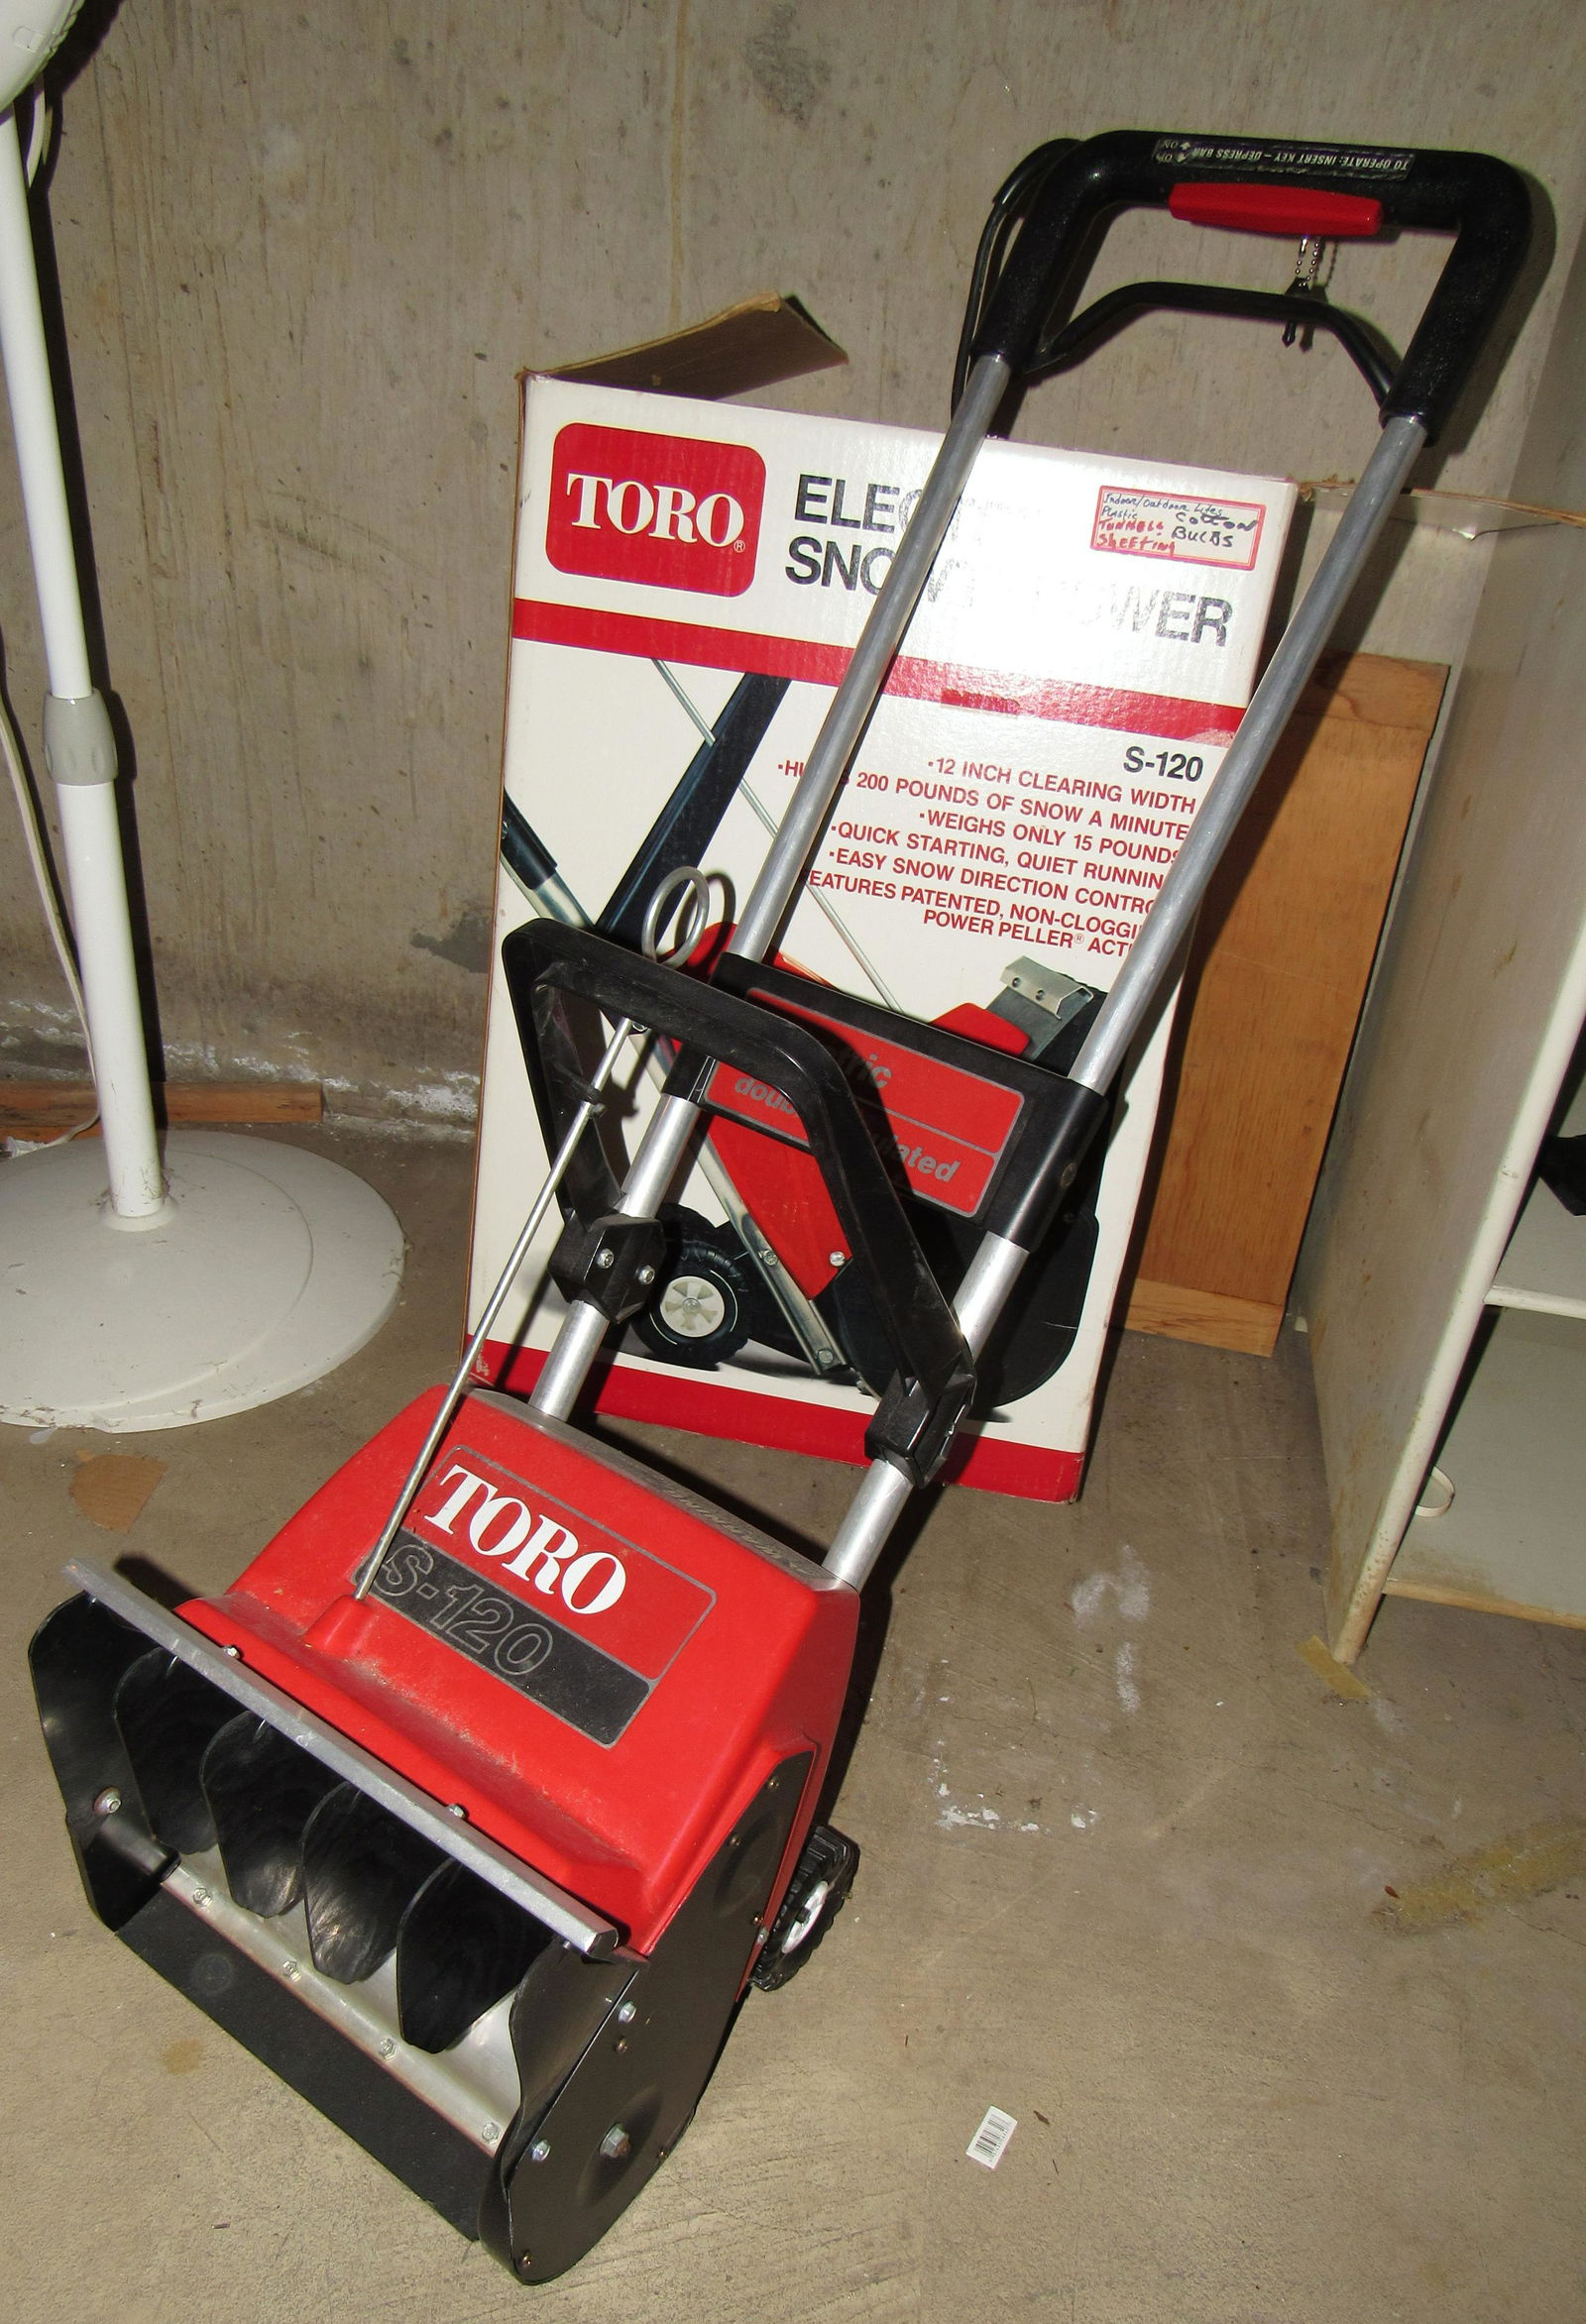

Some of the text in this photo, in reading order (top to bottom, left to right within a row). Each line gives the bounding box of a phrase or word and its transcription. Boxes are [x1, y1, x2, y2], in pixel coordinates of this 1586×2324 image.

[1216, 149, 1263, 162] DEPRESS
[1275, 153, 1295, 164] KEY
[1297, 154, 1338, 166] INSERT
[1394, 160, 1411, 171] TO
[962, 760, 1012, 784] INCH
[1018, 770, 1123, 803] CLEARING
[1130, 788, 1196, 815] WIDTH
[1123, 745, 1204, 782] S-120
[856, 771, 889, 792] 200
[895, 777, 979, 807] POUNDS
[986, 792, 1015, 812] OF
[1019, 798, 1083, 824] SNOW
[1088, 810, 1103, 828] A
[1109, 813, 1190, 841] MINUTE
[927, 809, 1006, 837] WEIGHS
[1012, 824, 1067, 846] ONLY
[1073, 833, 1093, 851] 15
[838, 821, 1165, 891] QUICK STARTING, QUIET RUNNIN
[836, 847, 1156, 915] EASY SNOW DIRECTION CONTRO
[809, 870, 1143, 941] EATURES PATENTED, NON-CLOGGI
[923, 909, 993, 936] POWER
[424, 1463, 627, 1615] TORO
[373, 1543, 554, 1677] S-120
